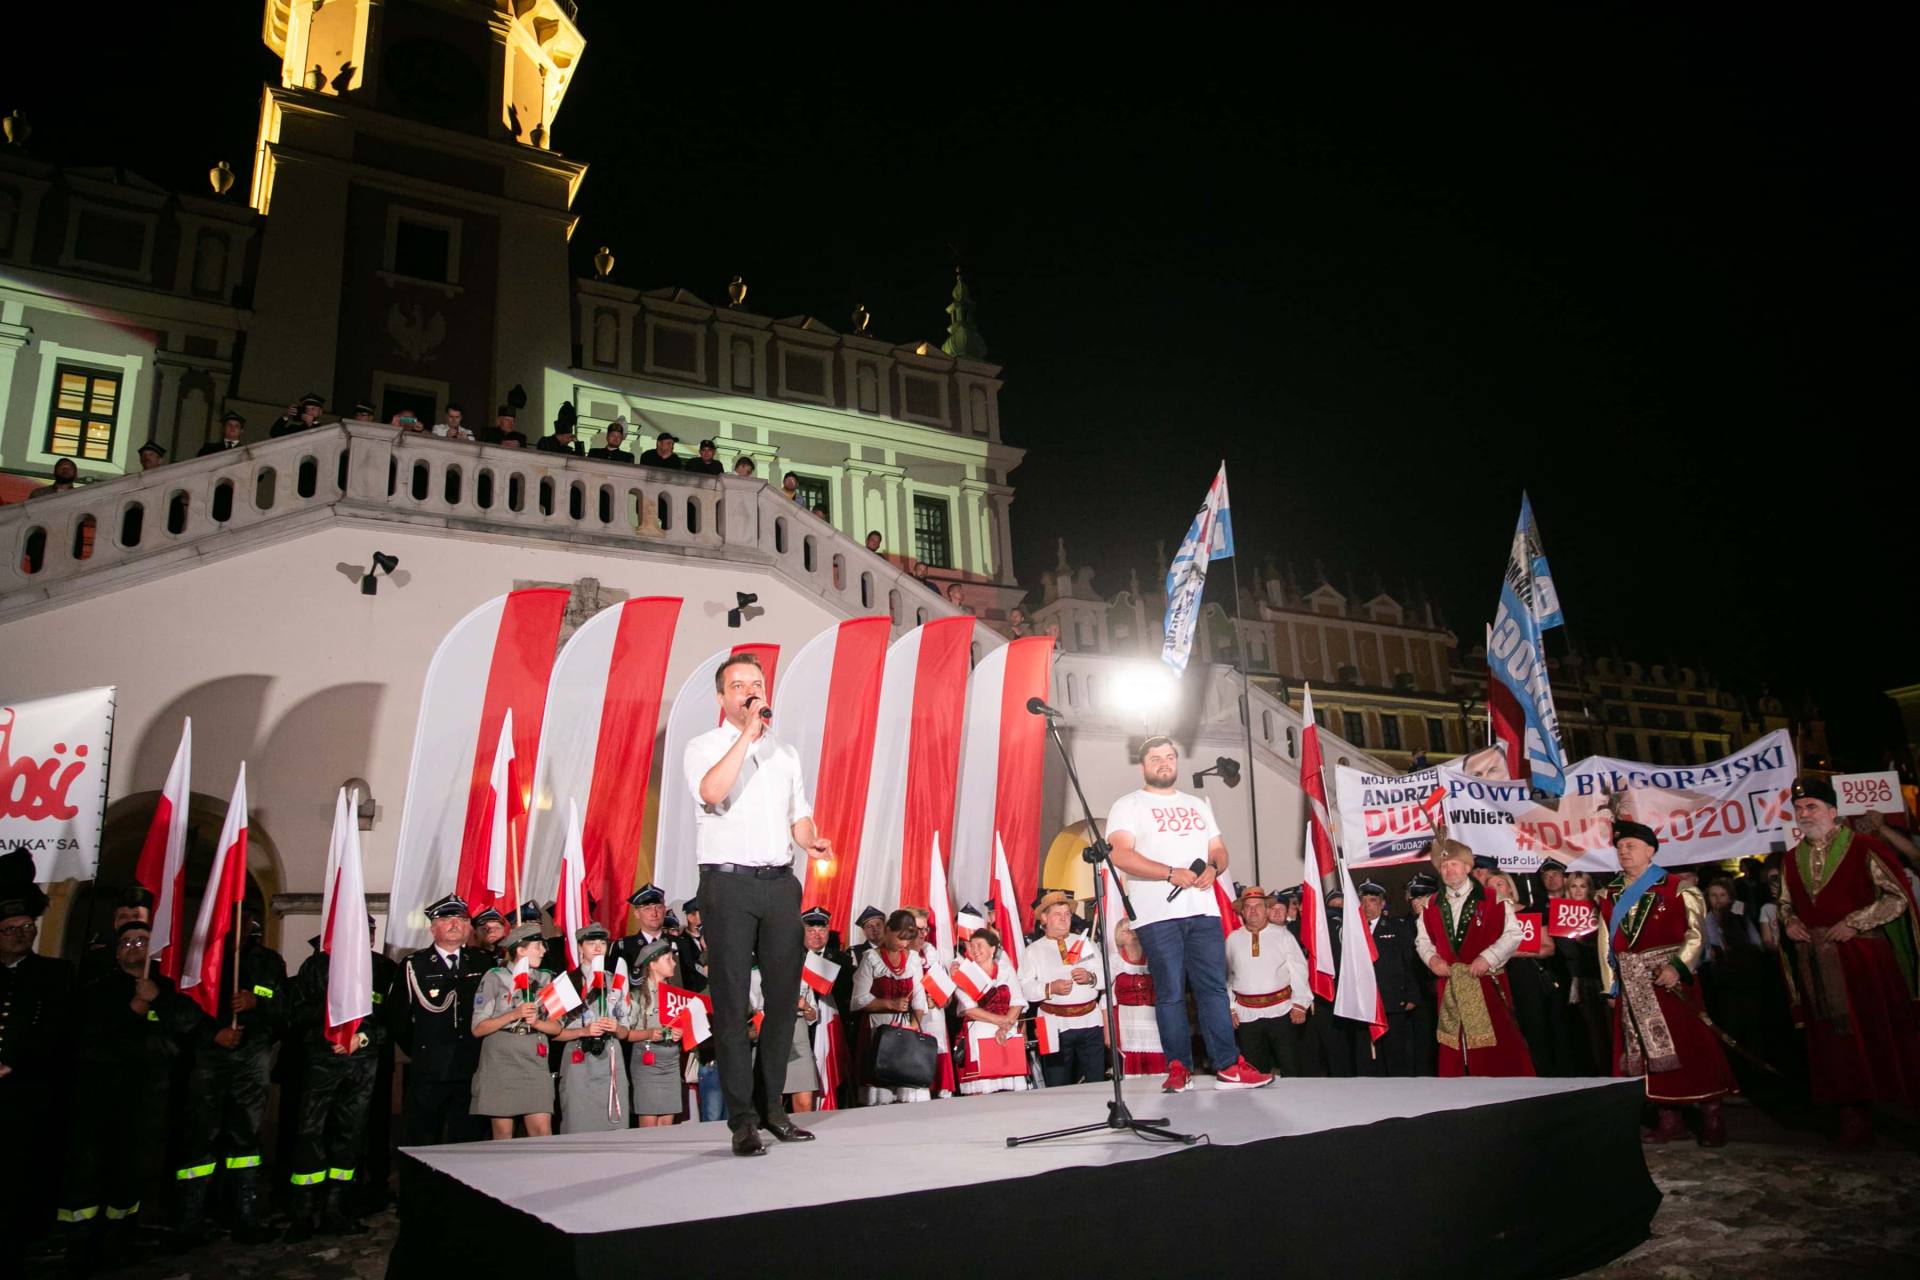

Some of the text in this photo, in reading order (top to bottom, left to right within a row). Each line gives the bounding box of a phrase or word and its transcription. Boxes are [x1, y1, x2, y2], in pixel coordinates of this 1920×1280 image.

[1842, 779, 1890, 793] DUDA
[1844, 790, 1893, 804] 2020
[1152, 807, 1200, 819] DUDA
[1450, 808, 1515, 825] wybiera
[1156, 817, 1206, 833] 2020
[1516, 800, 1746, 851] #DUD2020
[57, 838, 80, 850] SA
[1557, 915, 1599, 928] 2020
